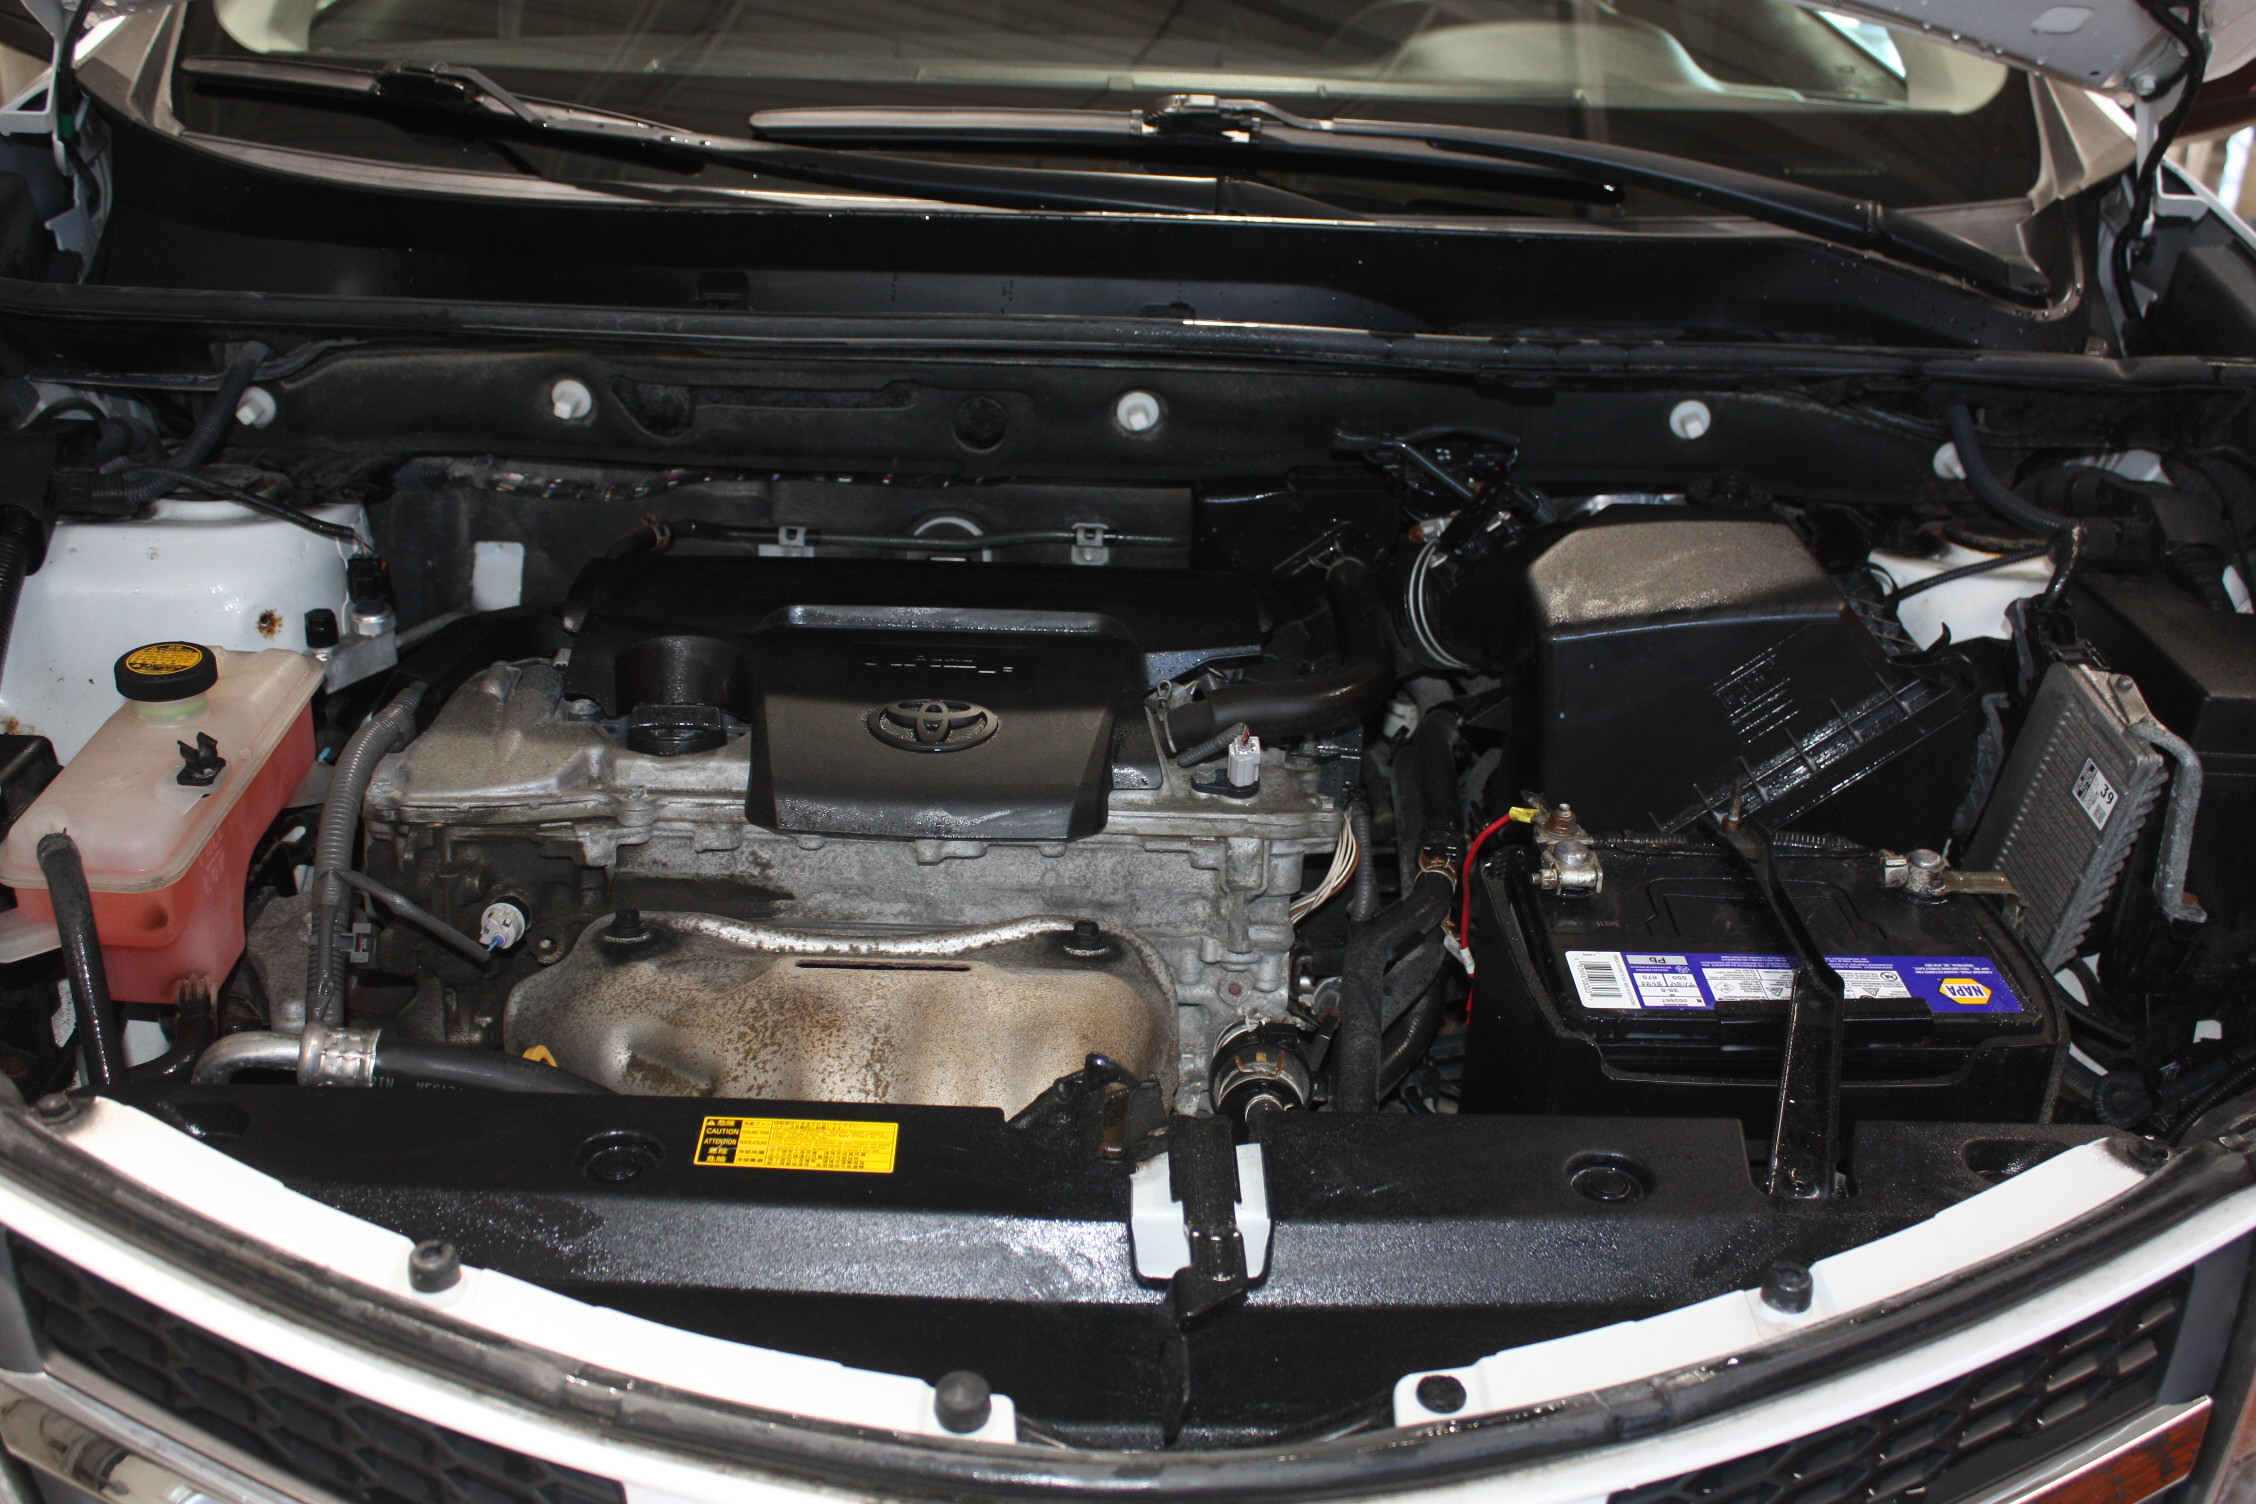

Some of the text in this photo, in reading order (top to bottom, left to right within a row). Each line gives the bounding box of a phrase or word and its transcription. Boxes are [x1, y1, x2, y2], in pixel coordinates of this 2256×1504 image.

[2100, 783, 2114, 804] 39
[1649, 956, 1666, 964] Pb
[1946, 985, 1985, 997] NAPA
[706, 1127, 739, 1136] CAUTION
[703, 1138, 736, 1146] ATTENTION
